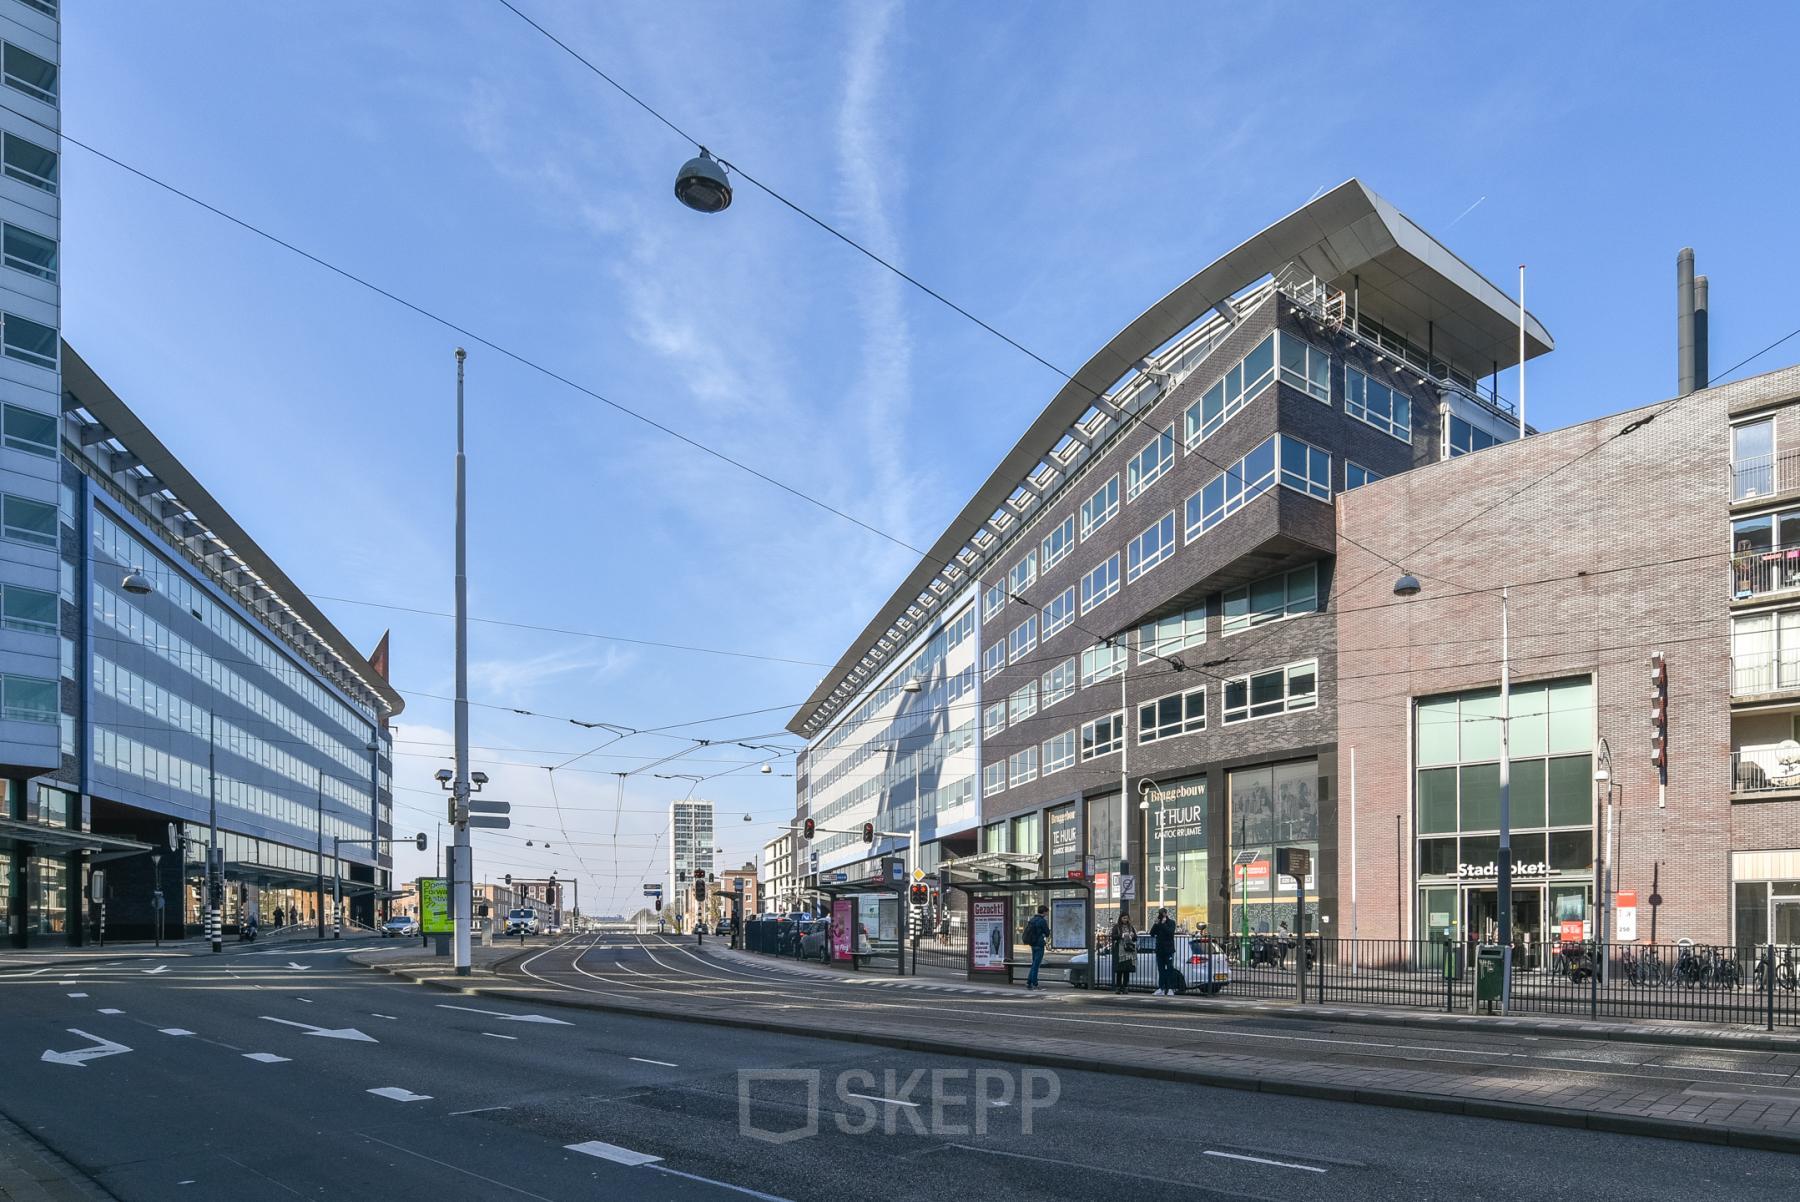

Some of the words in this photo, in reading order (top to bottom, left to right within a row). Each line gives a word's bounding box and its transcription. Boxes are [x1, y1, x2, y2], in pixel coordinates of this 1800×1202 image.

[1168, 805, 1201, 825] HUUR
[1053, 830, 1060, 844] TE
[1060, 827, 1077, 842] HUUR
[1459, 860, 1546, 877] Stadsoket
[975, 903, 1004, 915] Gezocht!
